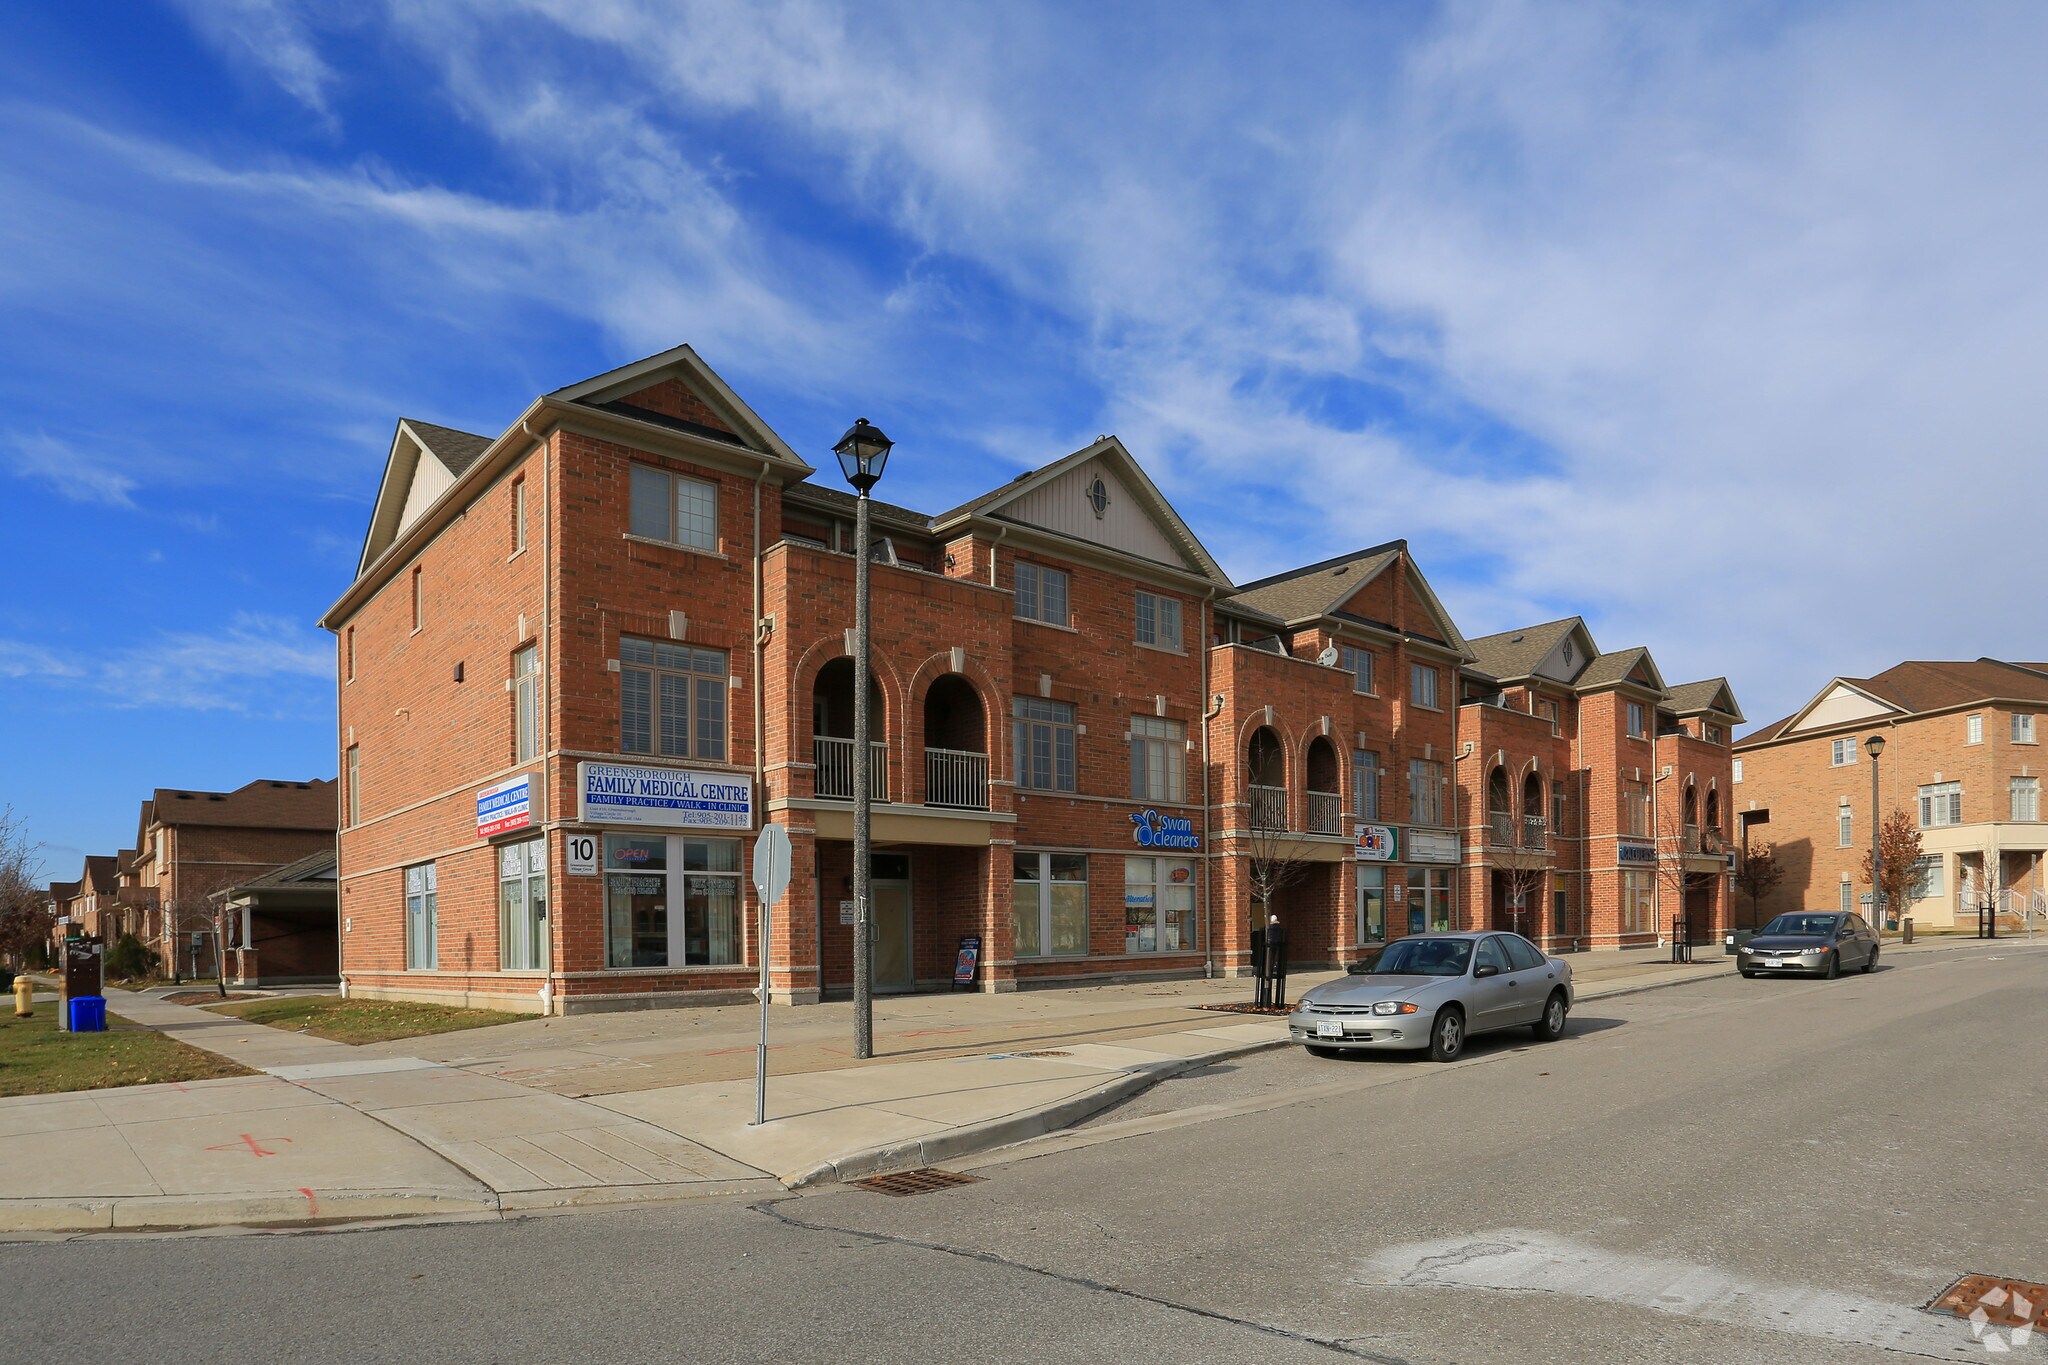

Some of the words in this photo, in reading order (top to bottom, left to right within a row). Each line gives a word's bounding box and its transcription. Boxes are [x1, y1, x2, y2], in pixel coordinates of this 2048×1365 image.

[589, 766, 691, 782] GREENSBOROUGH
[587, 776, 637, 794] FAMILY
[640, 780, 699, 798] MEDICAL
[701, 784, 749, 801] CENTRE
[591, 795, 625, 805] FAMILY
[626, 797, 669, 808] PRACTICE
[677, 800, 701, 809] WALK
[718, 803, 745, 812] CLINIC
[1162, 815, 1191, 831] Swan
[1154, 830, 1199, 848] Cleaners
[570, 839, 594, 861] 10
[614, 848, 649, 860] OPEN
